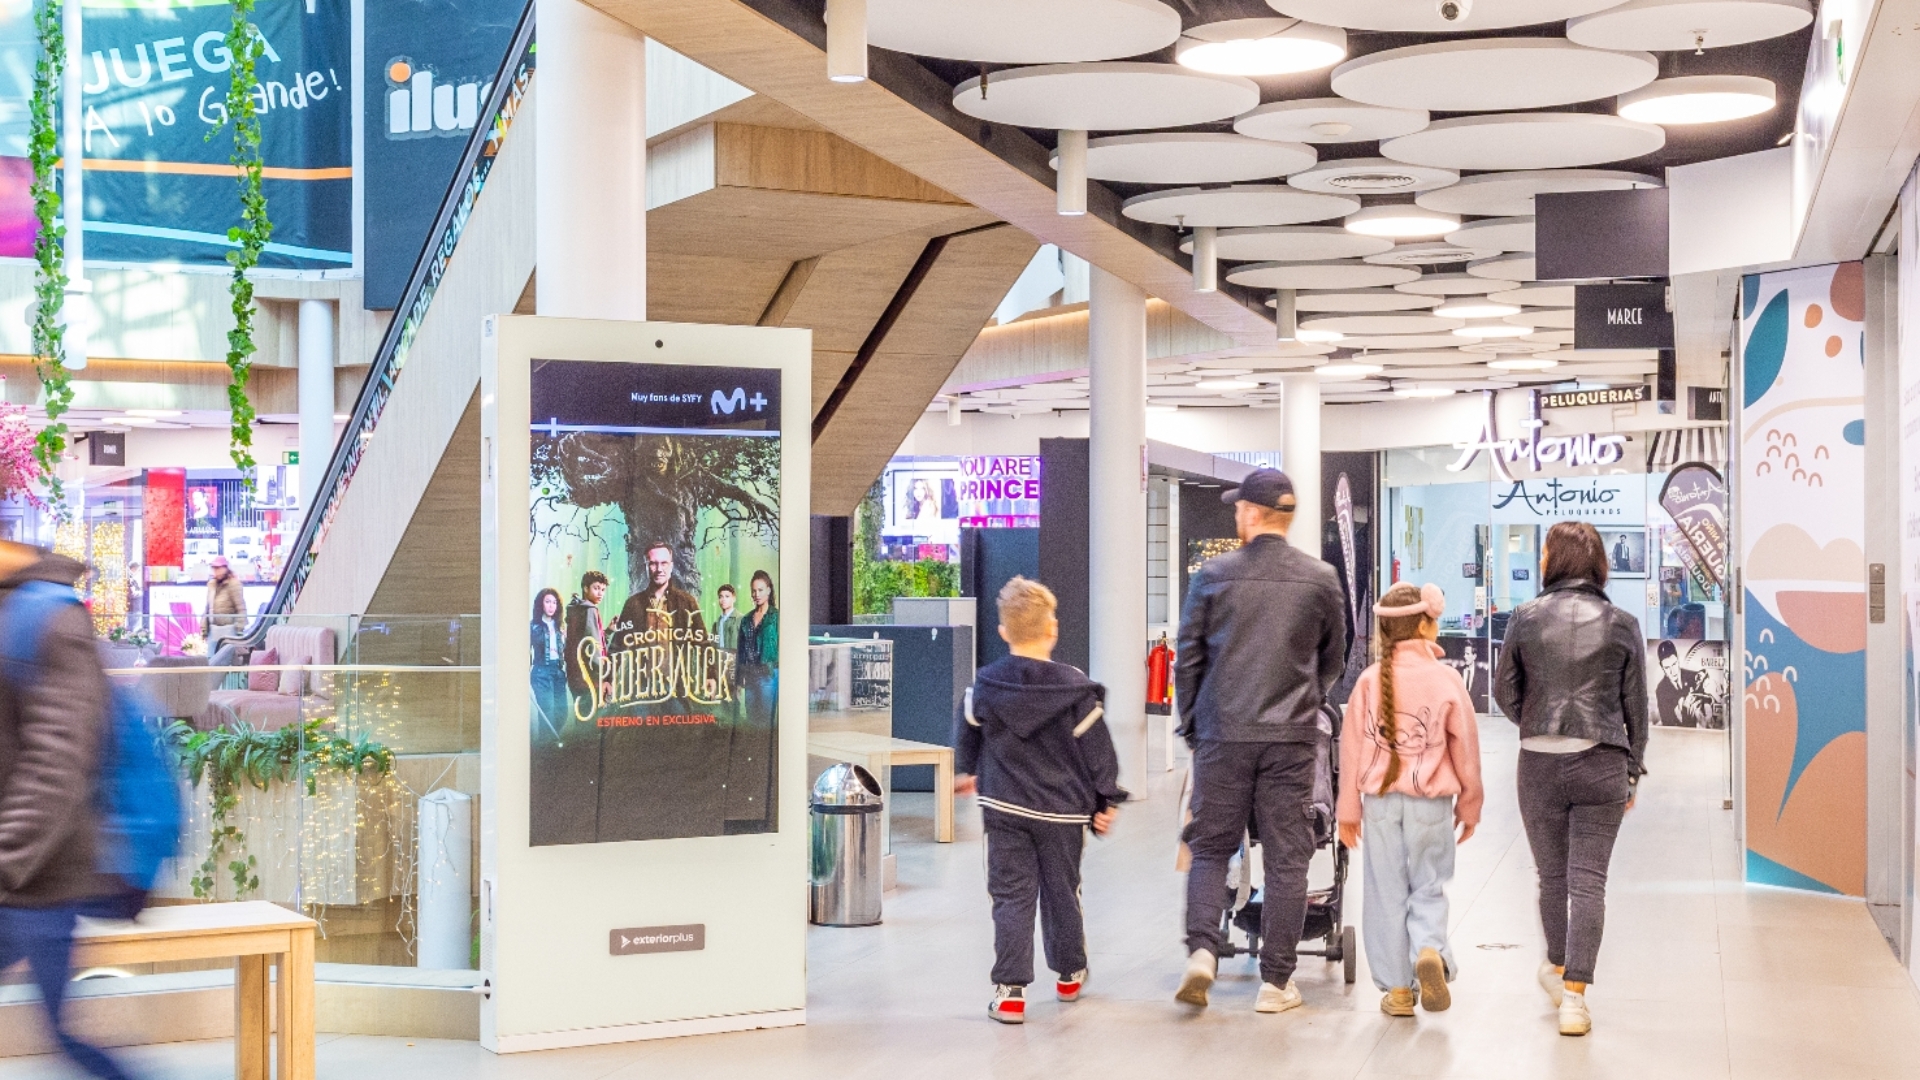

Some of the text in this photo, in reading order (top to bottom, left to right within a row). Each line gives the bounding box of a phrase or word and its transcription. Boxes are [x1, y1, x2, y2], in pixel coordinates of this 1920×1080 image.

[83, 23, 281, 95] JUEGA
[85, 68, 342, 152] A lo Gande!
[1607, 307, 1643, 325] MARCE
[670, 393, 681, 403] de
[682, 394, 703, 403] SYFY
[1541, 386, 1645, 408] PELUQUERIAS
[1446, 389, 1627, 484] Antonio
[990, 458, 1031, 475] ARE
[1492, 477, 1621, 516] Antonio
[614, 620, 634, 631] LAS
[623, 626, 720, 647] CRÓNICAS DE
[574, 620, 732, 722] SPIDERWICK
[597, 714, 716, 727] ESTRENO EN EXCLUSIVA
[633, 933, 694, 945] exteriorplus
